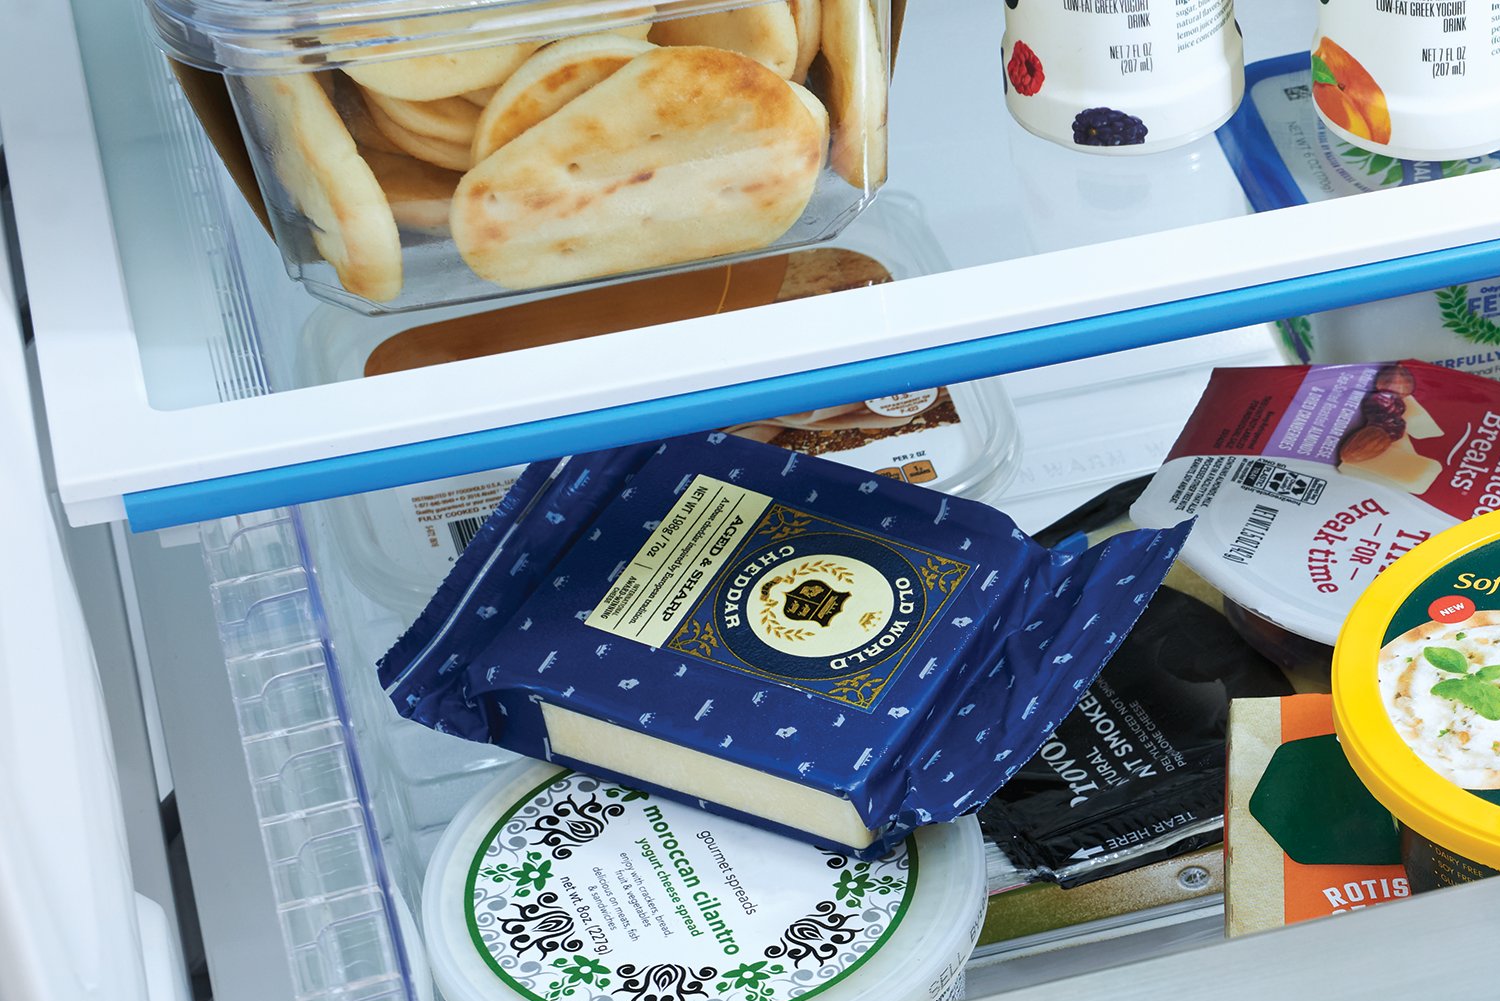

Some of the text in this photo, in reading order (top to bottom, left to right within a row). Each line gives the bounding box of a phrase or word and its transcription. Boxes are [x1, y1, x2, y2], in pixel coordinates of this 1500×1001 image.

[1095, 0, 1119, 14] GREEK
[1376, 0, 1467, 17] LOW-FAT GREEK YOGURT
[1127, 14, 1151, 29] DRINK
[1177, 26, 1200, 40] lemon
[1443, 18, 1468, 33] DRINK
[1109, 42, 1153, 60] NET 7 FL OZ
[1177, 41, 1195, 53] juice
[1421, 46, 1467, 62] NET 7 FL OZ
[1120, 60, 1138, 76] (207
[1432, 61, 1466, 79] (207 mL)
[893, 454, 907, 463] PER
[916, 450, 927, 459] OZ
[417, 507, 480, 523] FULLY COOKED
[646, 485, 708, 559] NET WT 198g 7oz
[708, 501, 726, 522] robust
[1251, 504, 1279, 521] NET
[691, 520, 712, 544] cheddar
[1307, 498, 1390, 594] break time
[677, 541, 697, 567] inspired
[1349, 537, 1382, 566] FOR
[661, 514, 744, 623] AGED & SHARP
[648, 570, 675, 603] European
[724, 545, 796, 629] CHEDDAR
[628, 598, 653, 625] tradition.
[829, 576, 915, 671] OLD WORLD
[1439, 601, 1466, 618] NEW
[1110, 698, 1152, 743] SLICED NOT
[1128, 698, 1157, 733] CHEESE
[1105, 810, 1199, 850] TEAR HERE
[695, 830, 758, 916] gourmet spreads
[1435, 846, 1484, 878] DAIRY FREE
[1437, 860, 1454, 873] SOY
[633, 836, 705, 938] yogurt cheese spread
[642, 804, 741, 956] moroccan cilantro
[592, 865, 614, 898] delicious
[614, 905, 632, 931] meats,
[626, 928, 640, 943] fish
[614, 868, 629, 884] fruit
[626, 889, 652, 929] vegetables
[618, 851, 675, 938] enjoy with crackers, bread,
[559, 875, 614, 957] net wt. 8oz. (227g)
[589, 891, 618, 932] sandwiches
